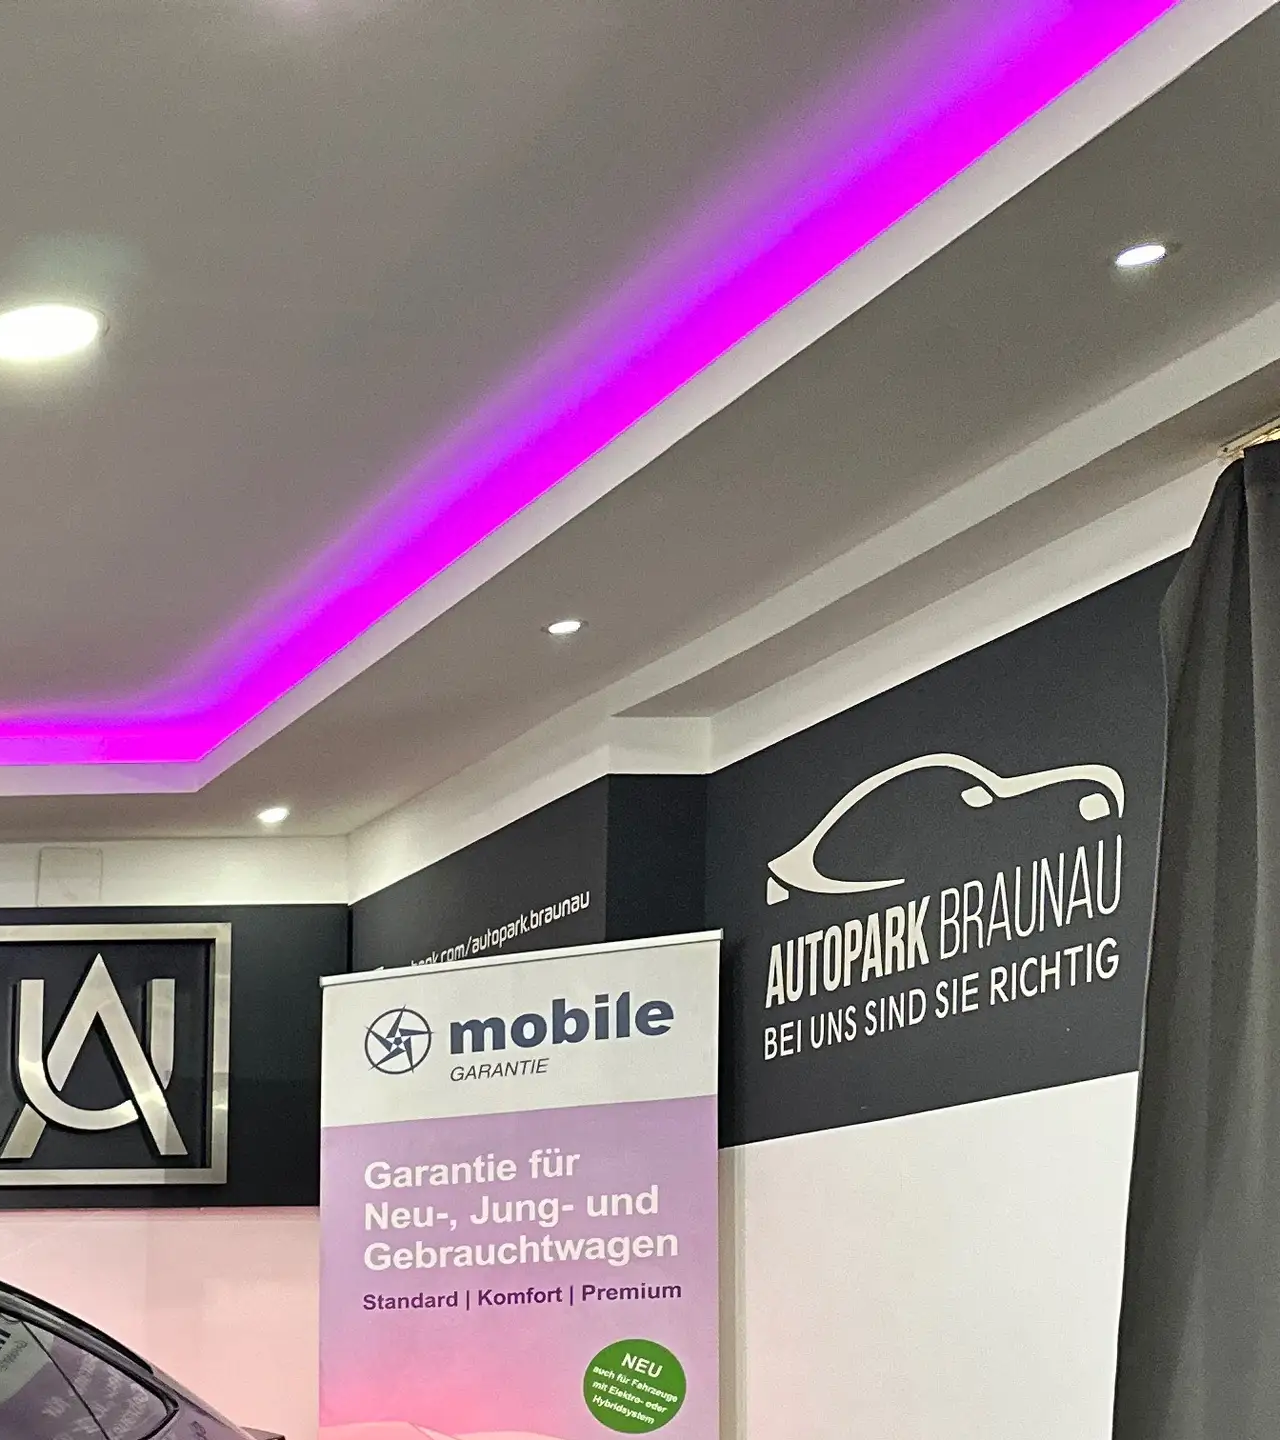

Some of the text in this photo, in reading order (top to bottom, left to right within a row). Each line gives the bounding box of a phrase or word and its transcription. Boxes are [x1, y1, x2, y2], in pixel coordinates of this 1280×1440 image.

[765, 834, 1122, 1009] AUTOPARK BRAUNAU
[764, 937, 1120, 1061] BEI UNS SIND SIE RICHTIG
[450, 991, 674, 1055] mobile
[450, 1057, 549, 1082] GARANTIE
[364, 1148, 580, 1189] Garantie für
[365, 1184, 659, 1231] Neu-, Jung- und
[363, 1233, 679, 1271] Gebrauchtwagen
[363, 1291, 459, 1311] Standard
[478, 1287, 563, 1306] Komfort
[582, 1282, 683, 1302] Premium
[621, 1353, 663, 1378] NEU
[592, 1381, 669, 1414] mit Elektro- oder
[593, 1366, 679, 1403] auch für Fahrzeuge
[592, 1395, 656, 1425] Hybridsystem
